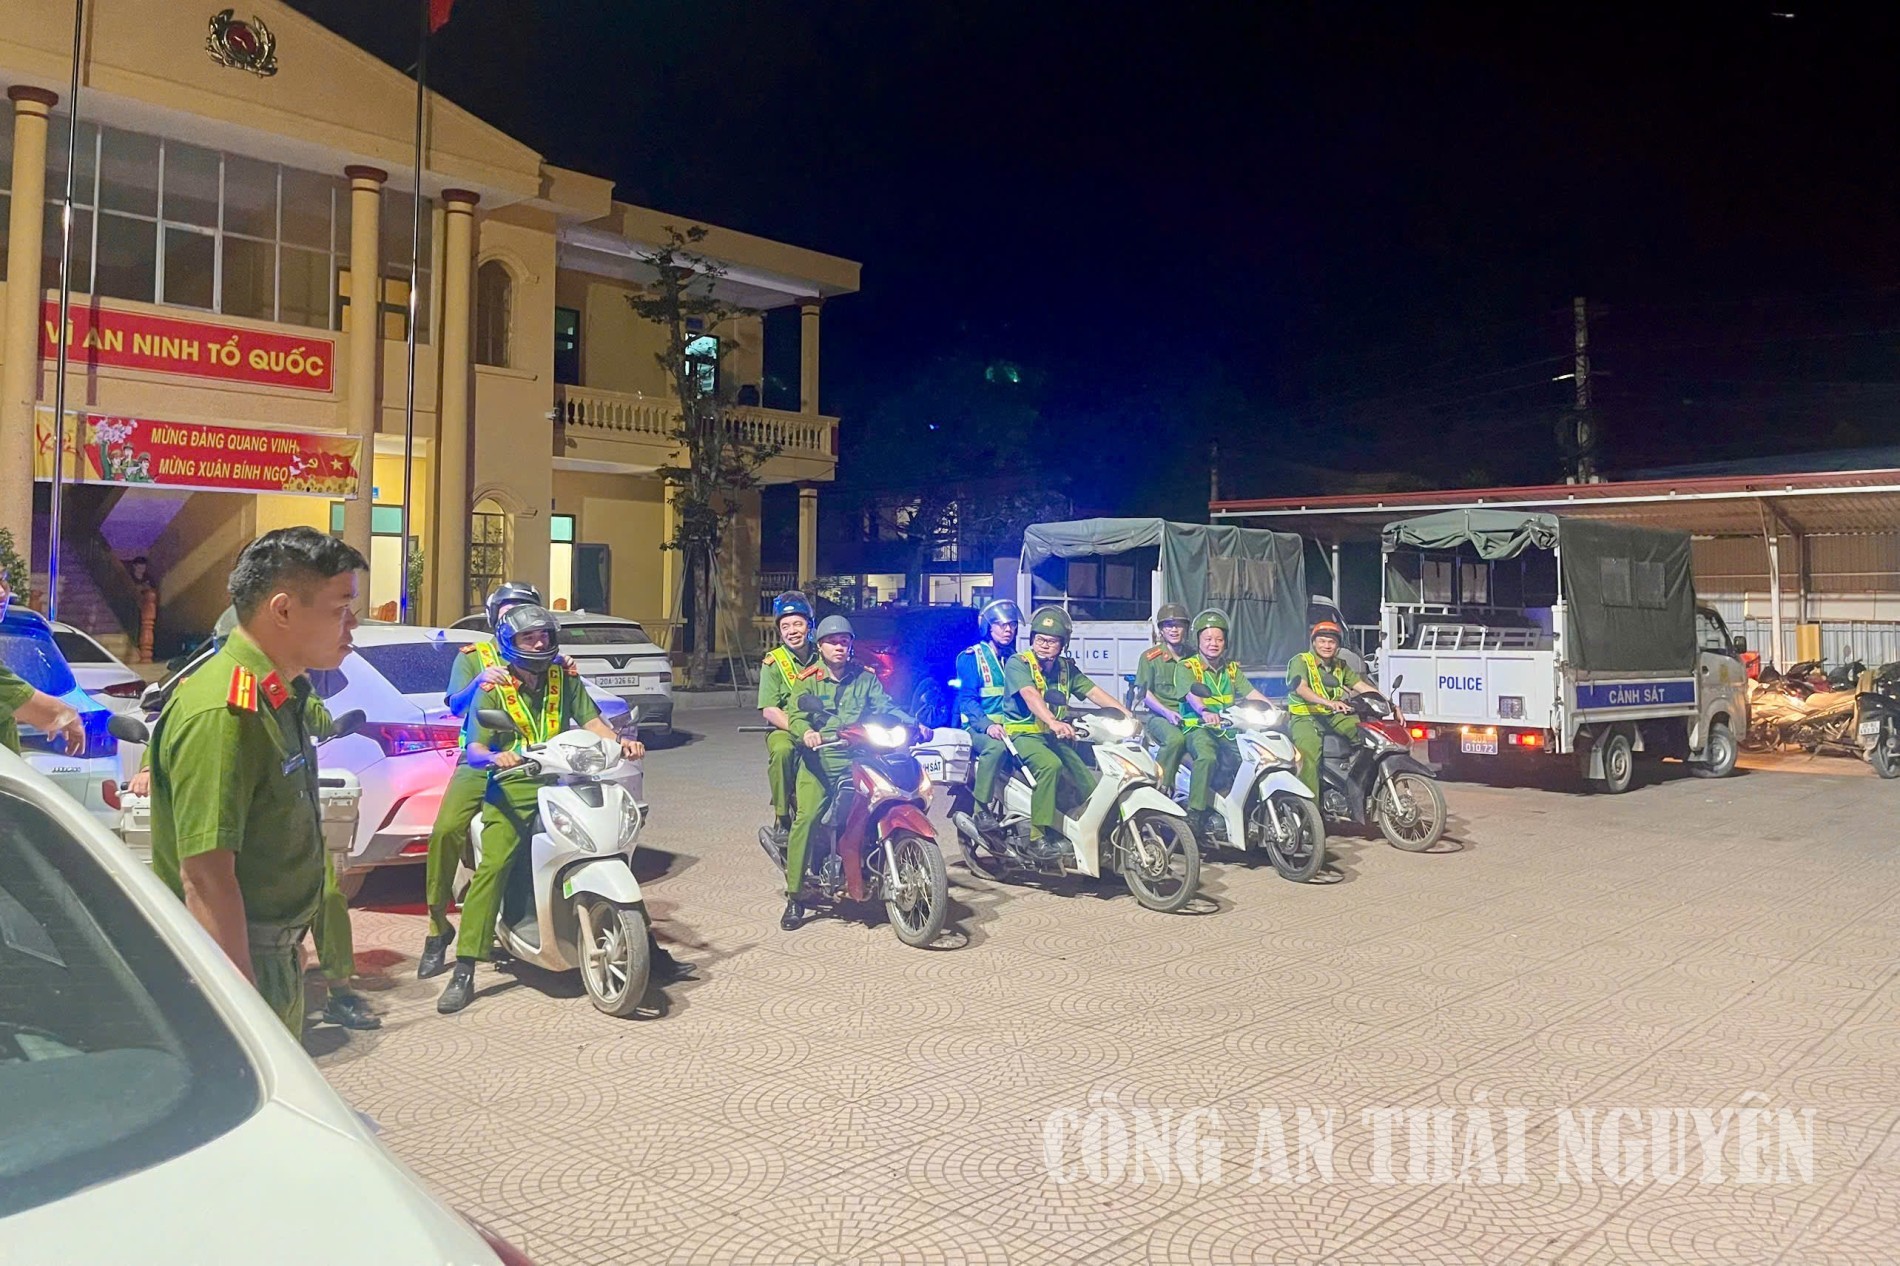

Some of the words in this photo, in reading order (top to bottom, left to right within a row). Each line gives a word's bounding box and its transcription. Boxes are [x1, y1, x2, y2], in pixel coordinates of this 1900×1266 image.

[45, 318, 74, 346] VÌ
[82, 327, 124, 352] AN
[133, 333, 199, 361] NINH
[207, 335, 241, 367] TỔ
[249, 346, 324, 376] QUỐC
[151, 424, 188, 446] MỪNG
[190, 426, 225, 449] ĐẢNG
[227, 434, 267, 452] QUANG
[271, 437, 297, 454] VINH
[159, 455, 195, 476] MỪNG
[198, 459, 231, 479] XUÂN
[232, 460, 261, 480] BÍNH
[1065, 650, 1109, 660] OLICE
[1439, 676, 1482, 691] POLICE
[1609, 685, 1640, 704] CẢNH
[1644, 685, 1665, 702] SÁT
[549, 669, 559, 729] CSTT
